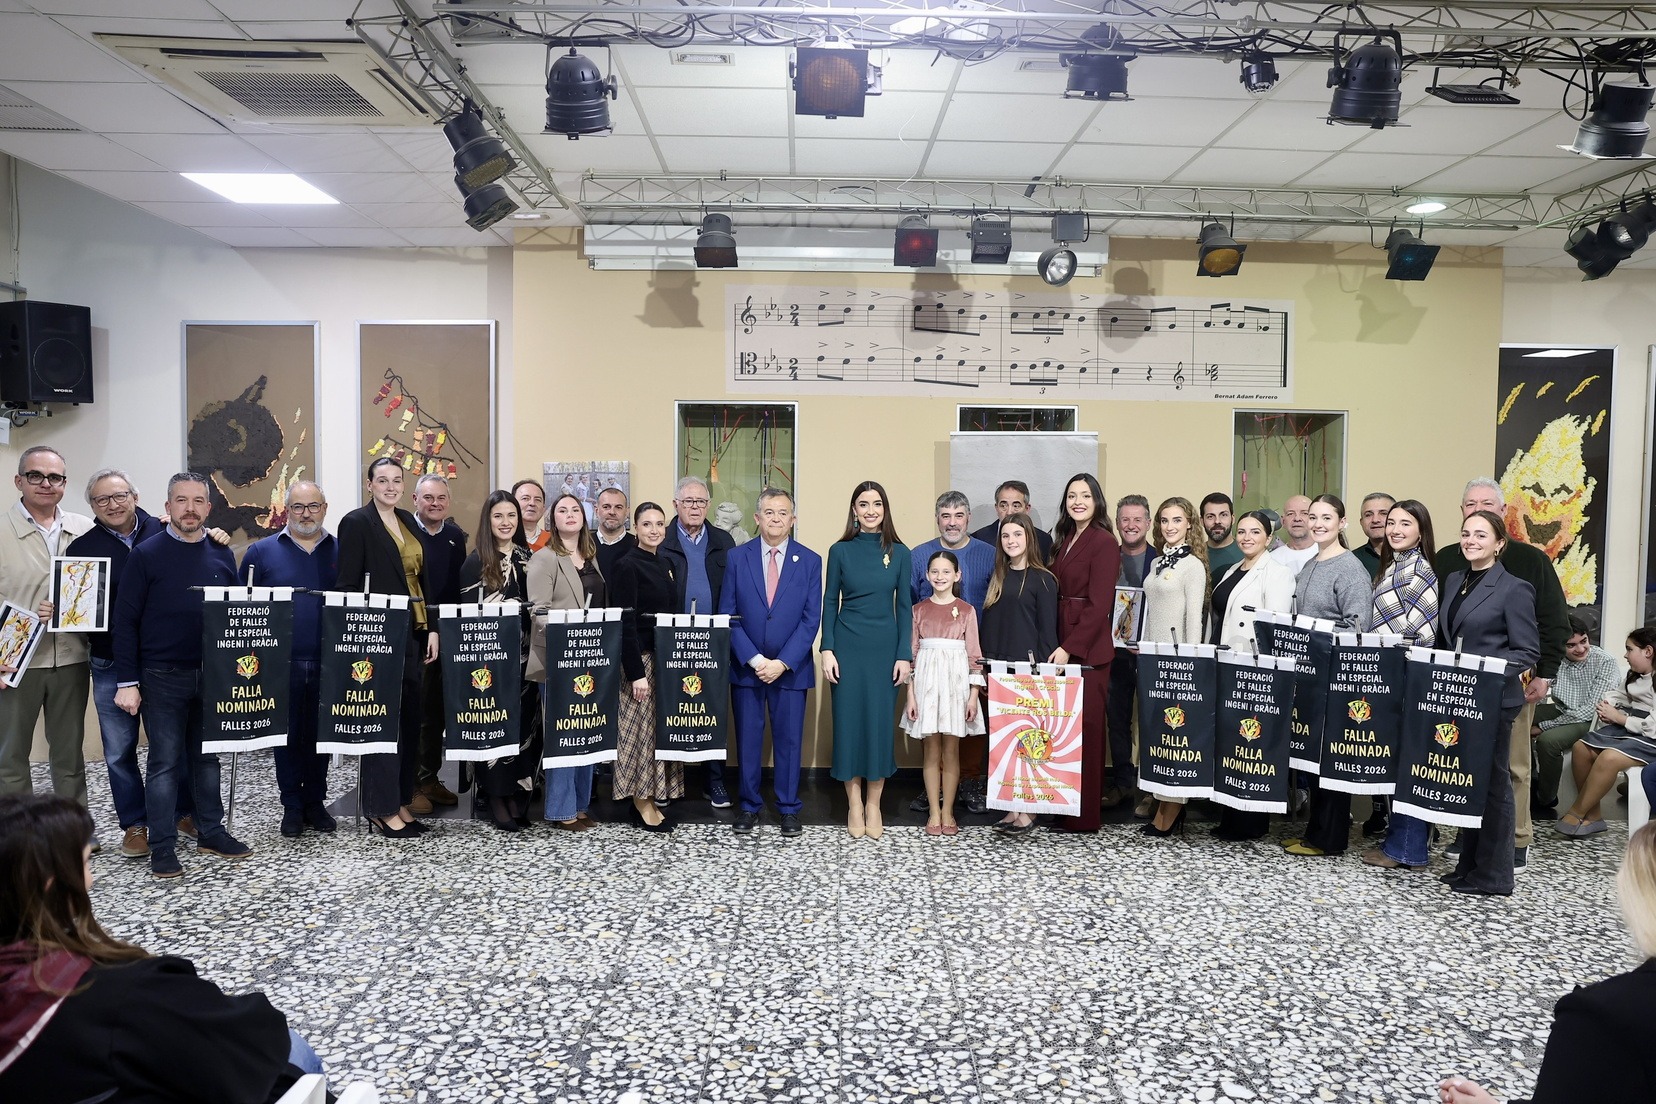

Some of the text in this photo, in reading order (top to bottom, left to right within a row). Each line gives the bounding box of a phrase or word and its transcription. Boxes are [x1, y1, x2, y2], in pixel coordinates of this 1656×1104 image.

[228, 606, 270, 616] FEDERACIÓ
[242, 618, 267, 626] FALLES
[346, 613, 386, 622] FEDERACIÓ
[359, 624, 383, 632] FALLES
[461, 621, 498, 631] FEDERACIÓ
[238, 628, 271, 637] ESPECIAL
[474, 632, 497, 641] FALLES
[567, 627, 602, 637] FEDERACIÓ
[675, 631, 710, 640] FEDERACIÓ
[1274, 629, 1310, 642] FEDERACIÓ
[217, 640, 244, 648] INGENI
[252, 637, 278, 647] GRÀCIA
[354, 634, 386, 643] ESPECIAL
[579, 639, 600, 647] FALLES
[335, 644, 359, 653] INGENI
[366, 644, 392, 654] GRÀCIA
[471, 642, 501, 651] ESPECIAL
[1274, 640, 1308, 652] DE FALLES
[454, 654, 476, 662] INGENI
[484, 651, 507, 661] GRÀCIA
[575, 648, 604, 657] ESPECIAL
[1340, 652, 1380, 661] FEDERACIÓ
[558, 660, 580, 668] INGENI
[587, 657, 610, 667] GRÀCIA
[695, 660, 718, 669] GRÀCIA
[1158, 661, 1194, 670] FEDERACIÓ
[1353, 664, 1378, 672] FALLES
[1170, 672, 1192, 680] FALLES
[1236, 671, 1273, 682] FEDERACIÓ
[1349, 674, 1383, 682] ESPECIAL
[1432, 671, 1477, 685] FEDERACIÓ
[232, 685, 261, 698] FALLA
[1166, 682, 1196, 691] ESPECIAL
[1237, 681, 1271, 692] DE FALLES
[1330, 683, 1354, 692] INGENI
[1362, 684, 1390, 694] GRÀCIA
[1433, 682, 1473, 695] DE FALLES
[346, 690, 374, 702] FALLA
[1149, 690, 1170, 699] INGENI
[1177, 692, 1202, 701] GRÀCIA
[1244, 692, 1275, 703] ESPECIAL
[1427, 692, 1476, 707] EN ESPECIAL
[217, 698, 275, 713] NOMINADA
[469, 697, 495, 709] FALLA
[679, 703, 705, 714] FALLA
[1016, 697, 1054, 709] PREMI
[1225, 700, 1248, 710] INGENI
[1254, 704, 1279, 714] GRÀCIA
[332, 704, 386, 717] NOMINADA
[570, 703, 598, 716] FALLA
[1418, 702, 1445, 714] INGENI
[1453, 707, 1482, 720] GRÀCIA
[457, 709, 507, 724] NOMINADA
[556, 714, 606, 730] NOMINADA
[666, 716, 716, 727] NOMINADA
[222, 718, 270, 730] FALLES 2026
[335, 724, 382, 734] FALLES 2026
[462, 729, 505, 740] FALLES 2026
[670, 733, 712, 742] FALLES 2026
[1345, 729, 1375, 742] FALLA
[560, 734, 602, 747] FALLES 2026
[1162, 734, 1188, 747] FALLA
[1290, 742, 1305, 750] 026
[1150, 746, 1201, 762] NOMINADA
[1236, 746, 1262, 760] FALLA
[1331, 742, 1390, 757] NOMINADA
[1428, 752, 1459, 769] FALLA
[1153, 765, 1174, 776] FALLES
[1223, 757, 1275, 776] NOMINADA
[1335, 762, 1386, 774] FALLES 2026
[1412, 765, 1472, 786] NOMINADA
[1225, 776, 1270, 792] FALLES 2026
[1413, 785, 1467, 804] FALLES 2026
